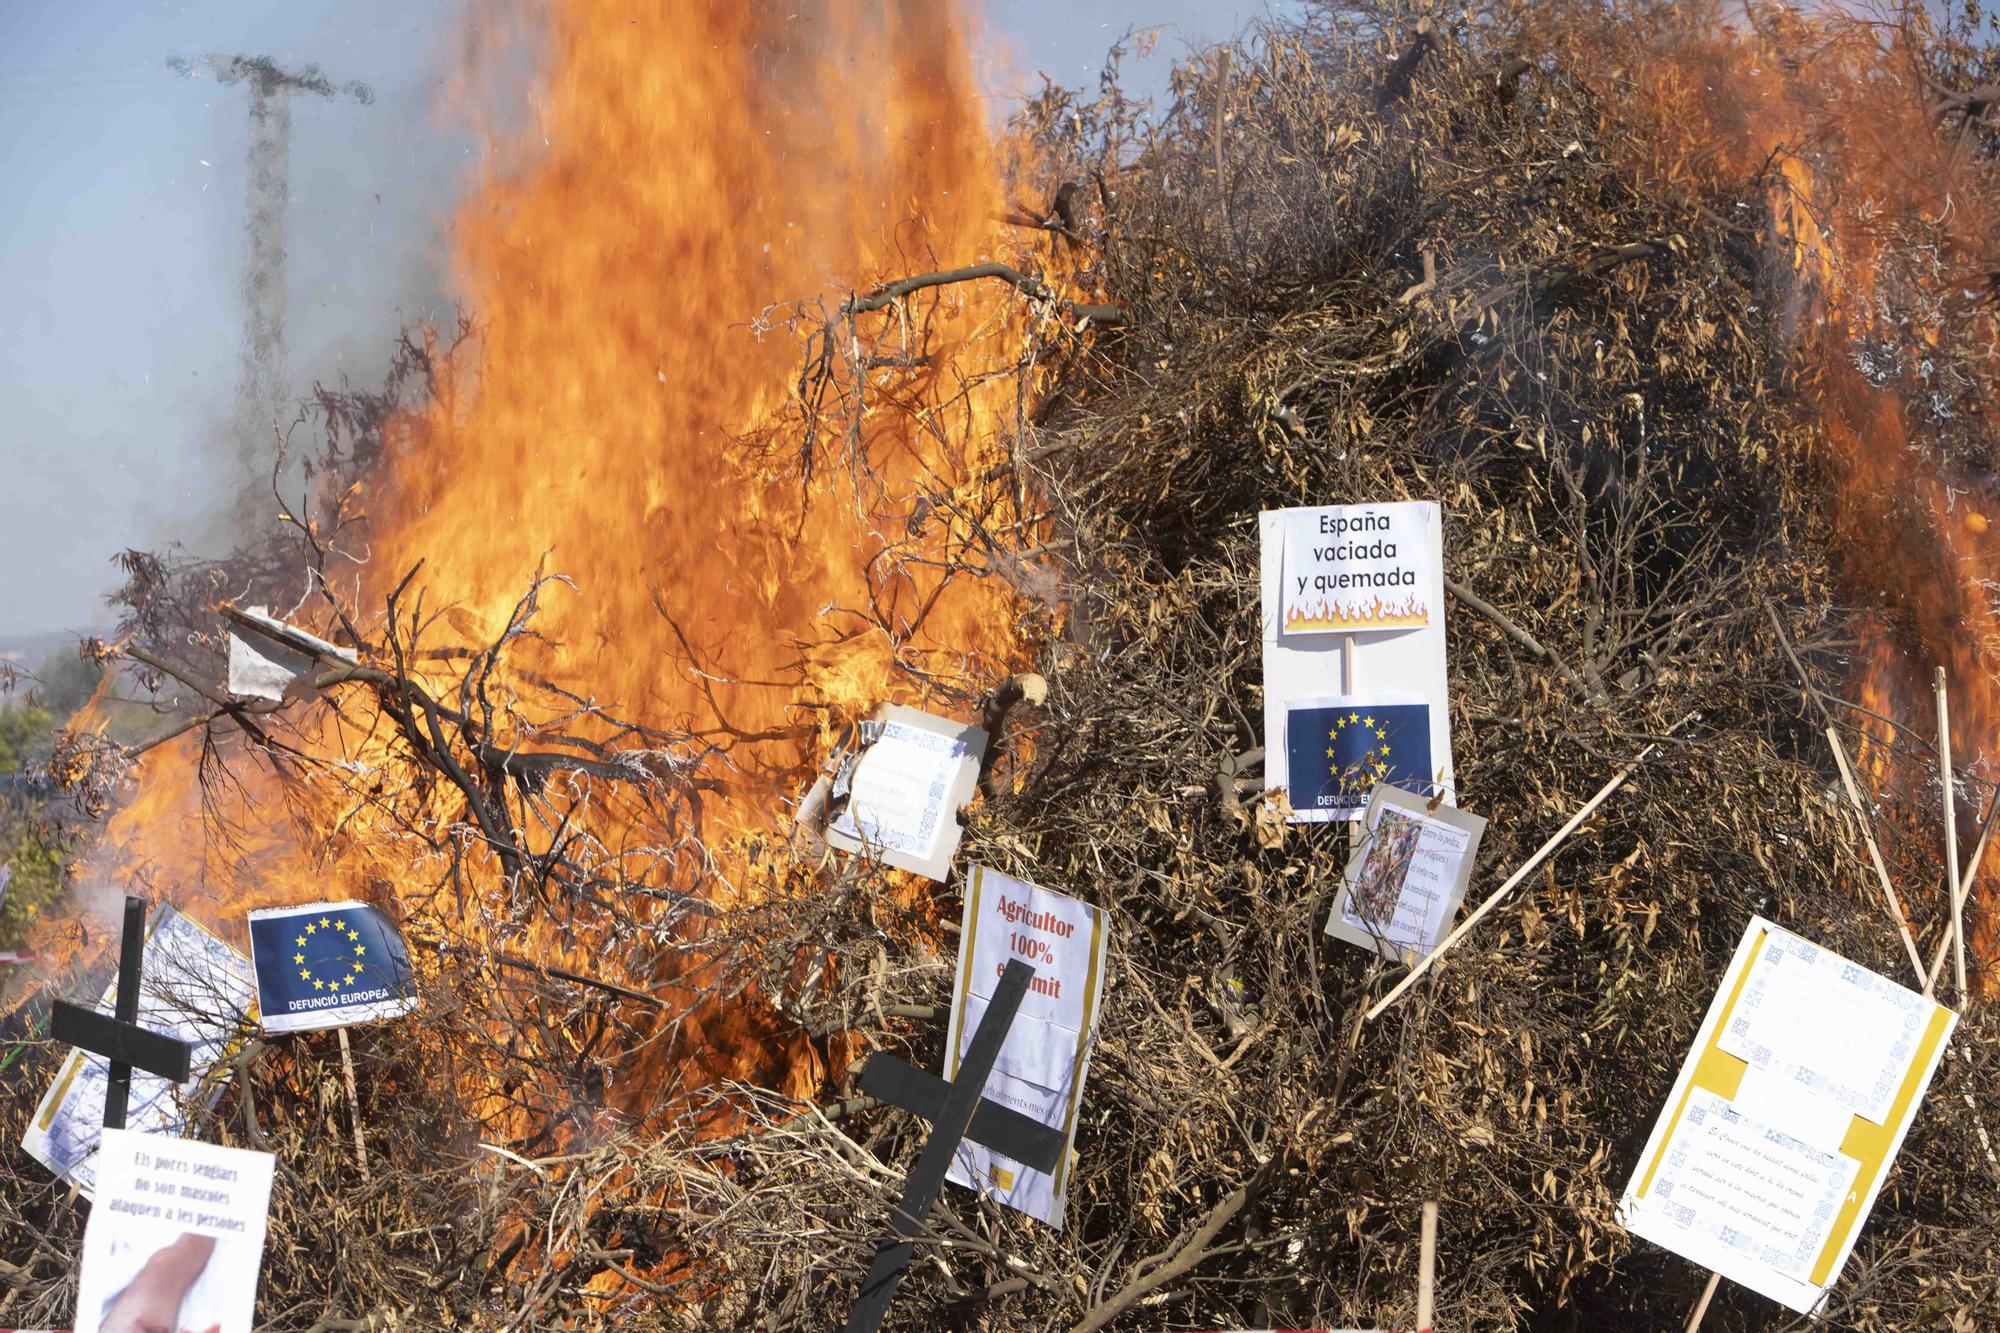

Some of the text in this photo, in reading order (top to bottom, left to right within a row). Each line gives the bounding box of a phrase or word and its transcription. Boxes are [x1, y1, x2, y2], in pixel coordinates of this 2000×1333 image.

[1320, 512, 1390, 537] España
[1314, 540, 1396, 562] vaciada
[1297, 567, 1415, 595] y quemada
[1317, 792, 1357, 806] DEFUNCÓ
[996, 895, 1074, 938] Agricultor
[1010, 931, 1053, 964] 100%
[289, 988, 389, 1010] DEFUNCIÓ EUROPEA
[134, 1151, 238, 1182] Els porcs senglars
[134, 1178, 150, 1191] no
[180, 1185, 230, 1205] mascotes
[109, 1197, 245, 1233] ataquen a les persones
